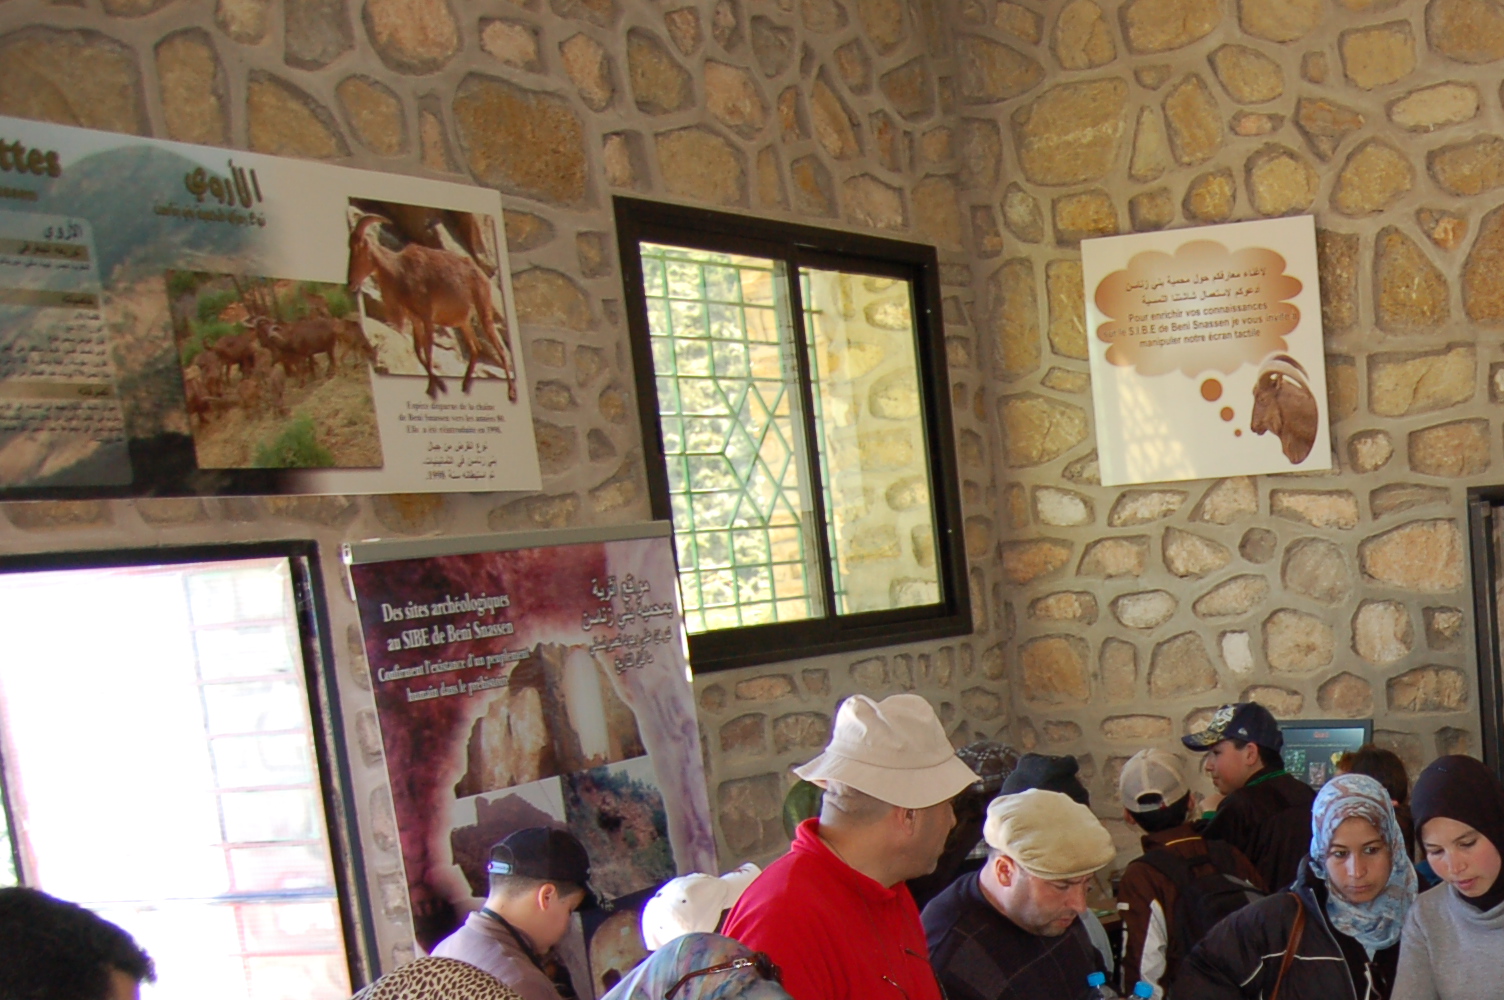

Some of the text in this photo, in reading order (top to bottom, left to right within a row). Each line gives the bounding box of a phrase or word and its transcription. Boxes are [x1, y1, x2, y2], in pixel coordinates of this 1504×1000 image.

[1151, 278, 1165, 290] بني
[1167, 275, 1190, 287] محمية
[1128, 303, 1268, 322] Pour enrichir vos connaissances
[1129, 324, 1156, 336] S.I.B.E
[1158, 324, 1169, 334] de
[1171, 322, 1190, 332] Beni
[1192, 319, 1230, 330] Snassen
[1231, 317, 1239, 328] je
[1242, 316, 1263, 325] vous
[1139, 328, 1260, 348] manipuler notre écran tactile
[381, 592, 510, 623] Des sites archéologiques
[387, 621, 514, 651] au SIBE de Beni Snassen
